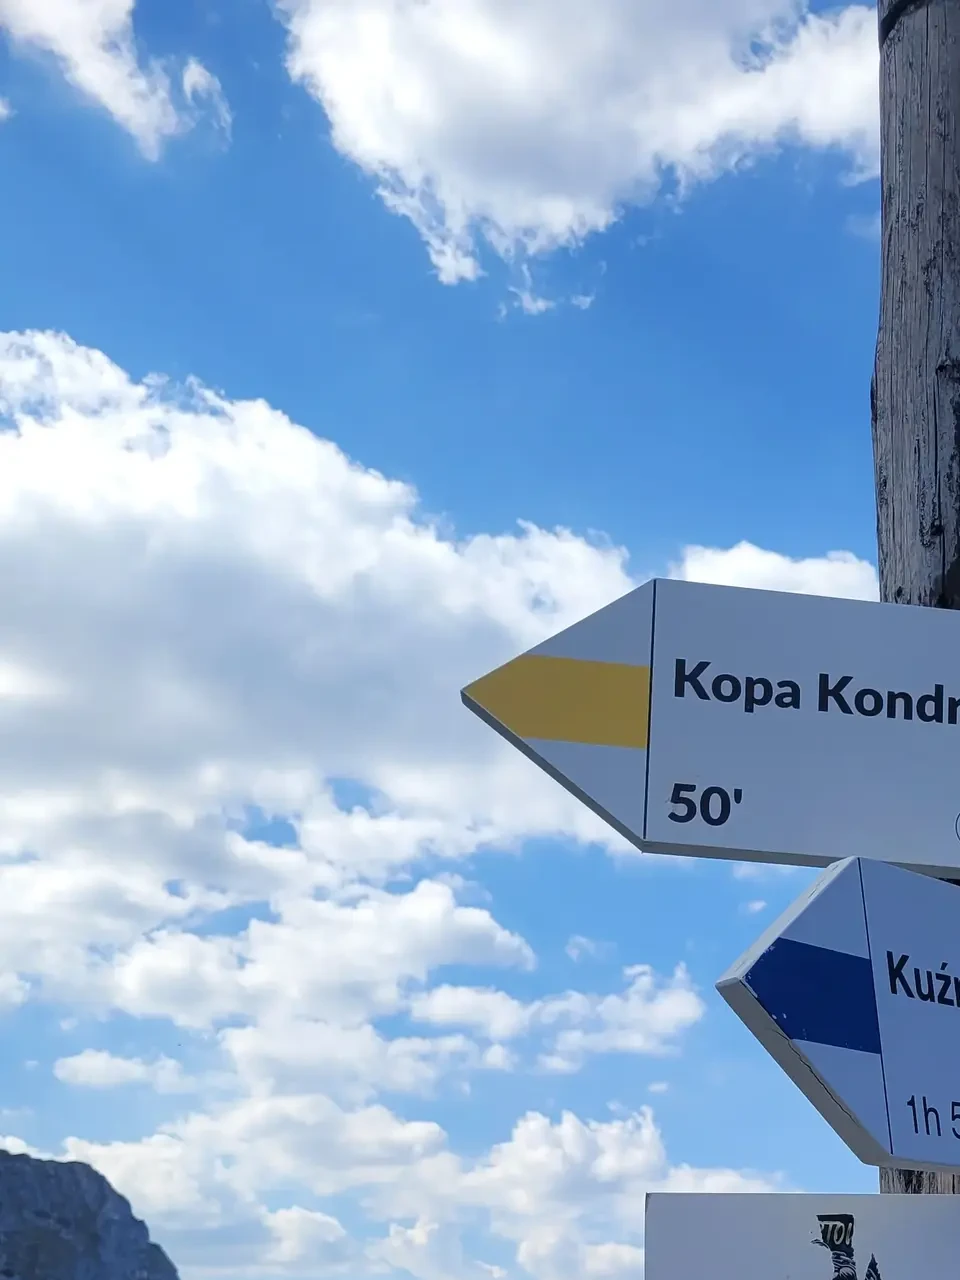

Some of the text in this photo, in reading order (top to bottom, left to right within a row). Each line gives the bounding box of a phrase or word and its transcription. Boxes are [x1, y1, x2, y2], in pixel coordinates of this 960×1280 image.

[675, 658, 800, 713] Kopa
[668, 783, 743, 826] 50'
[906, 1094, 942, 1138] 1h
